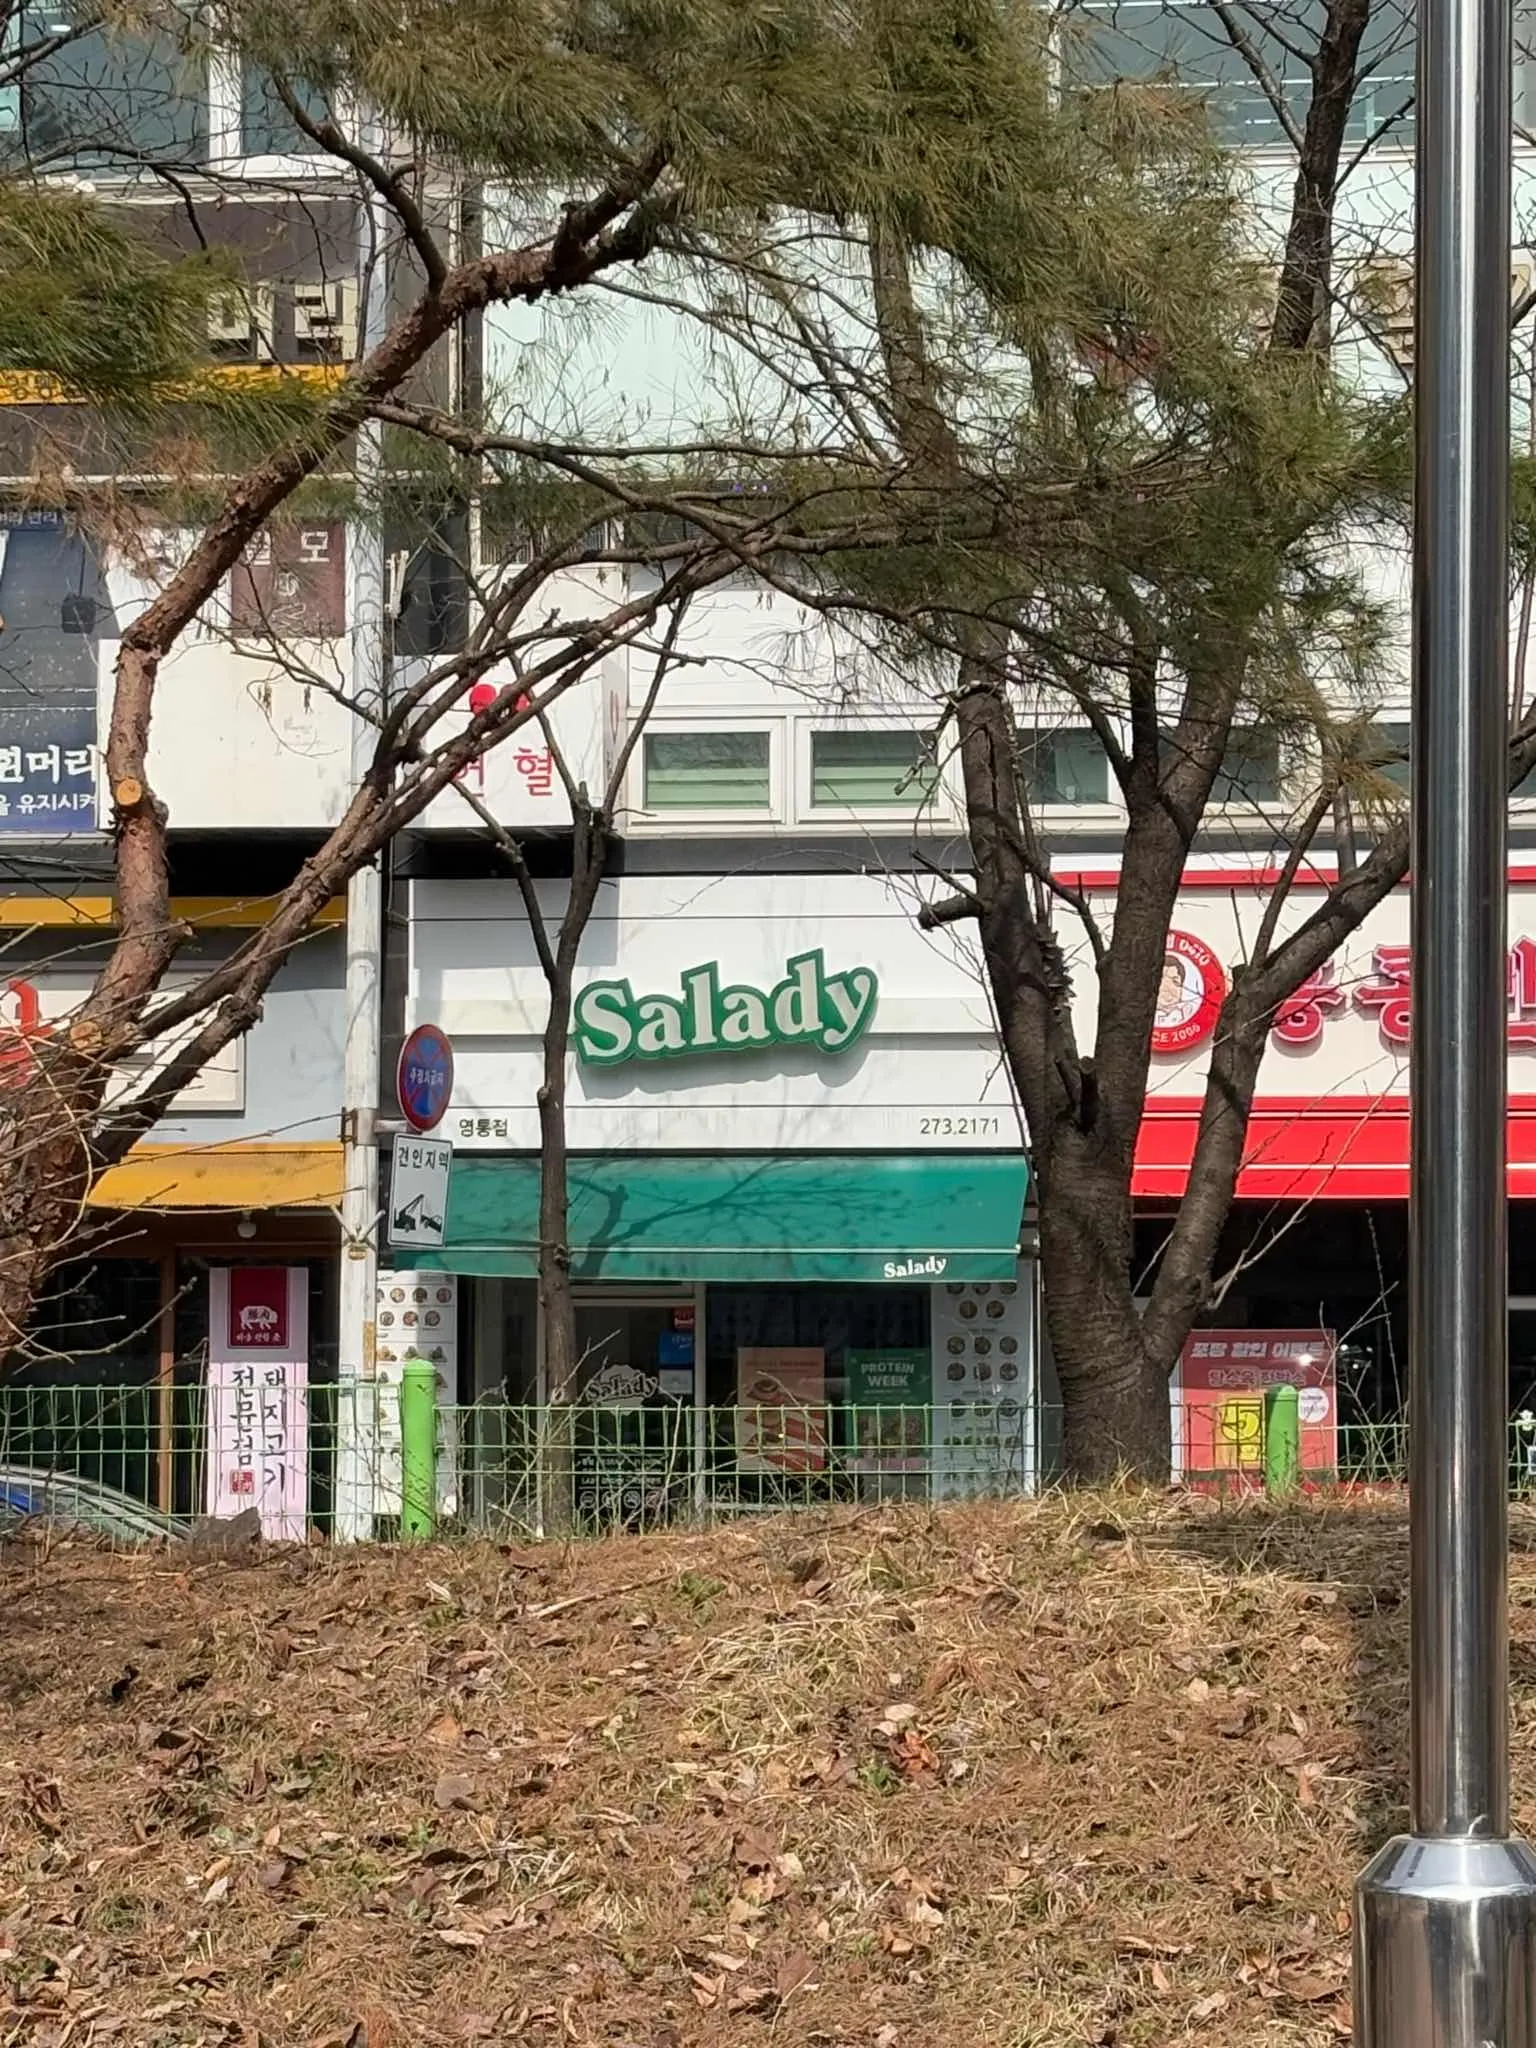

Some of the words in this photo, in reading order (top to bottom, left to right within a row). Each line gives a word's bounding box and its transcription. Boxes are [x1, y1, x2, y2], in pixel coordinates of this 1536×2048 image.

[577, 954, 873, 1060] Salady
[459, 1118, 509, 1138] 영통점
[920, 1118, 999, 1135] 273.2171
[398, 1147, 449, 1171] 견인지역
[884, 1256, 947, 1278] Salady
[861, 1362, 914, 1374] PROTEIN
[585, 1370, 657, 1401] Salady
[867, 1374, 909, 1387] WEEK
[230, 1366, 257, 1466] 전문점
